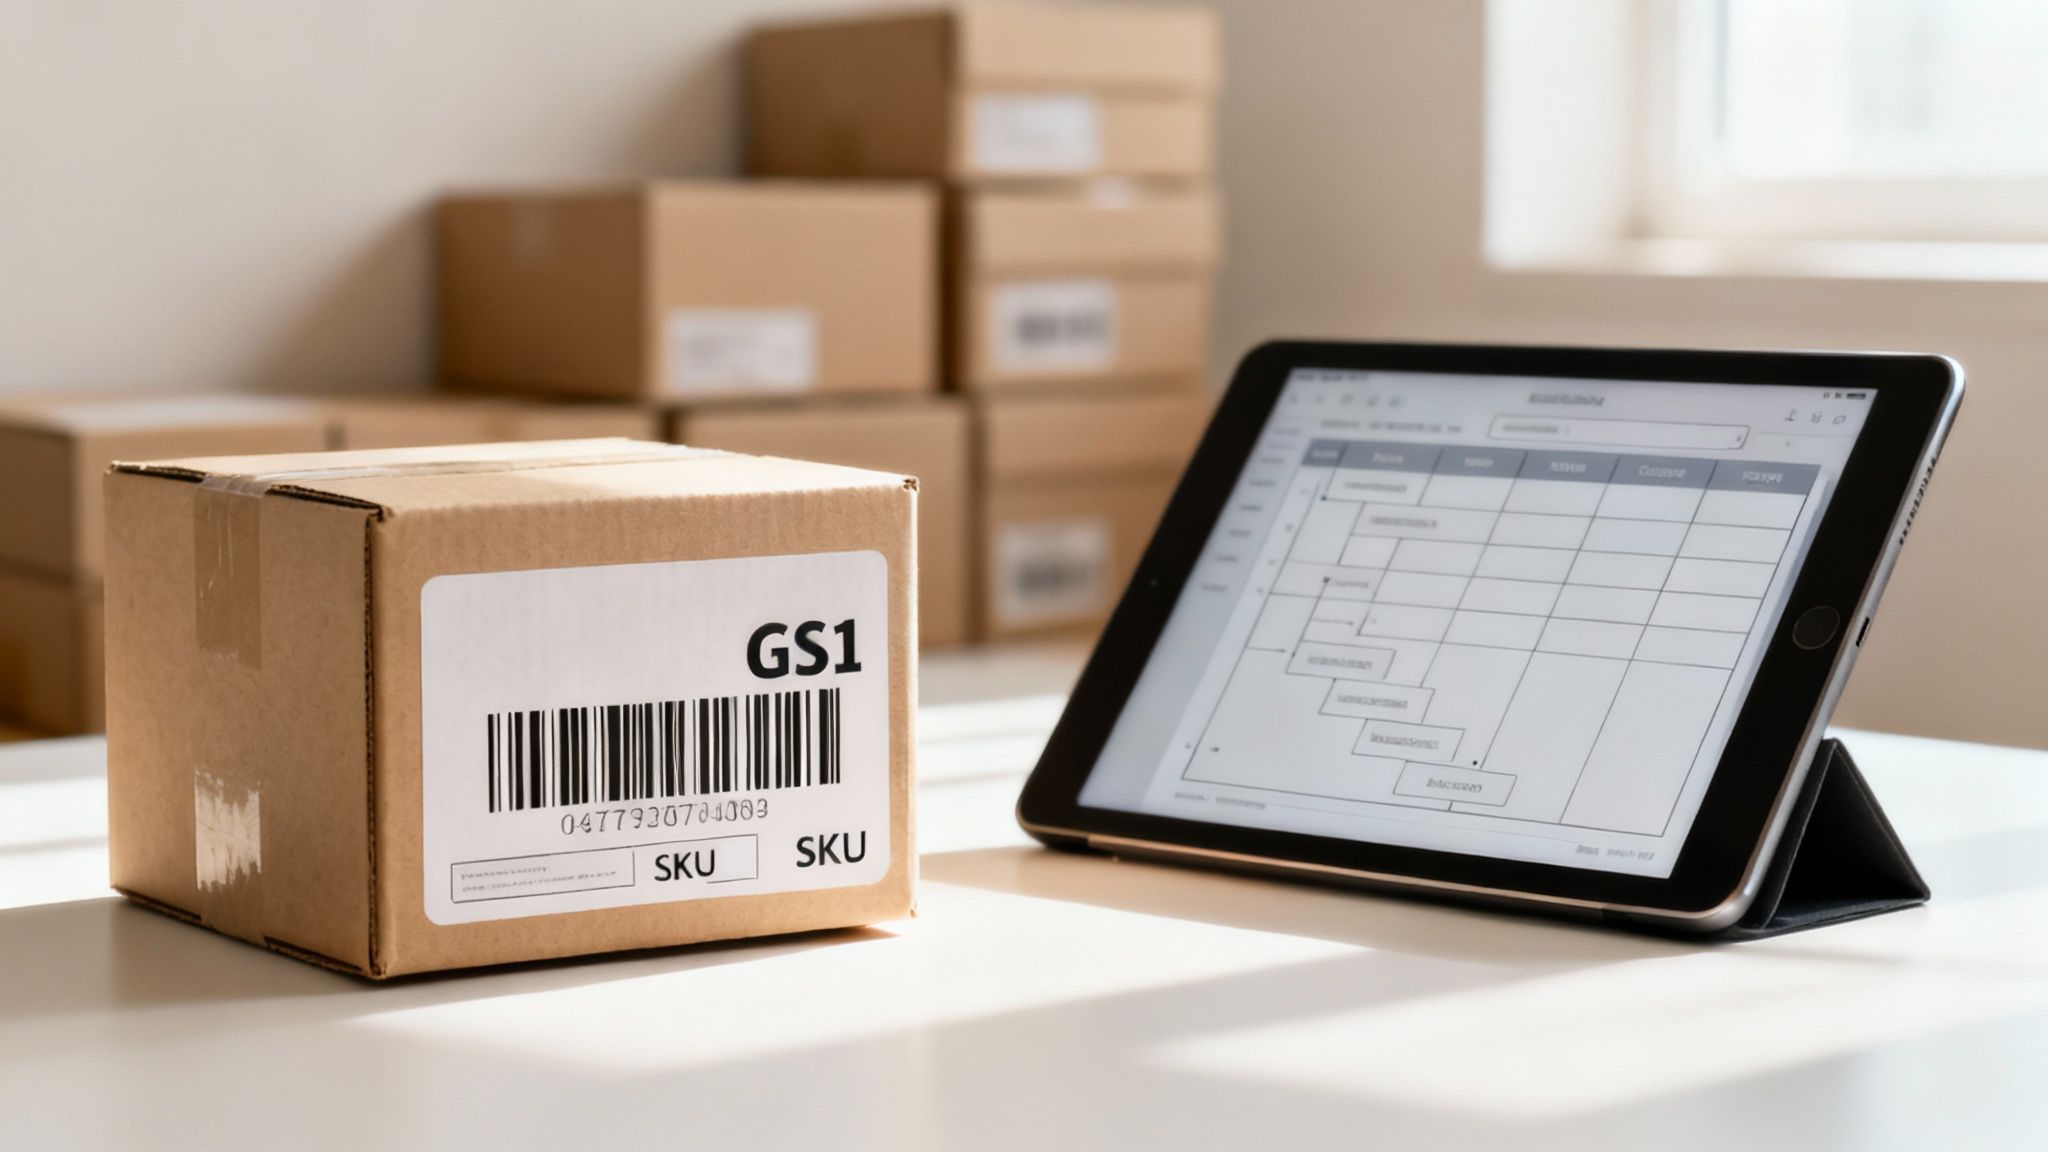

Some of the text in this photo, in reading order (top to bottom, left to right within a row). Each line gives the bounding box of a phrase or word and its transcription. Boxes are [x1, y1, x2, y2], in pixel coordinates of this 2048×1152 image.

[746, 618, 862, 680] GS1
[654, 849, 716, 882] SKU
[795, 830, 867, 868] SKU
